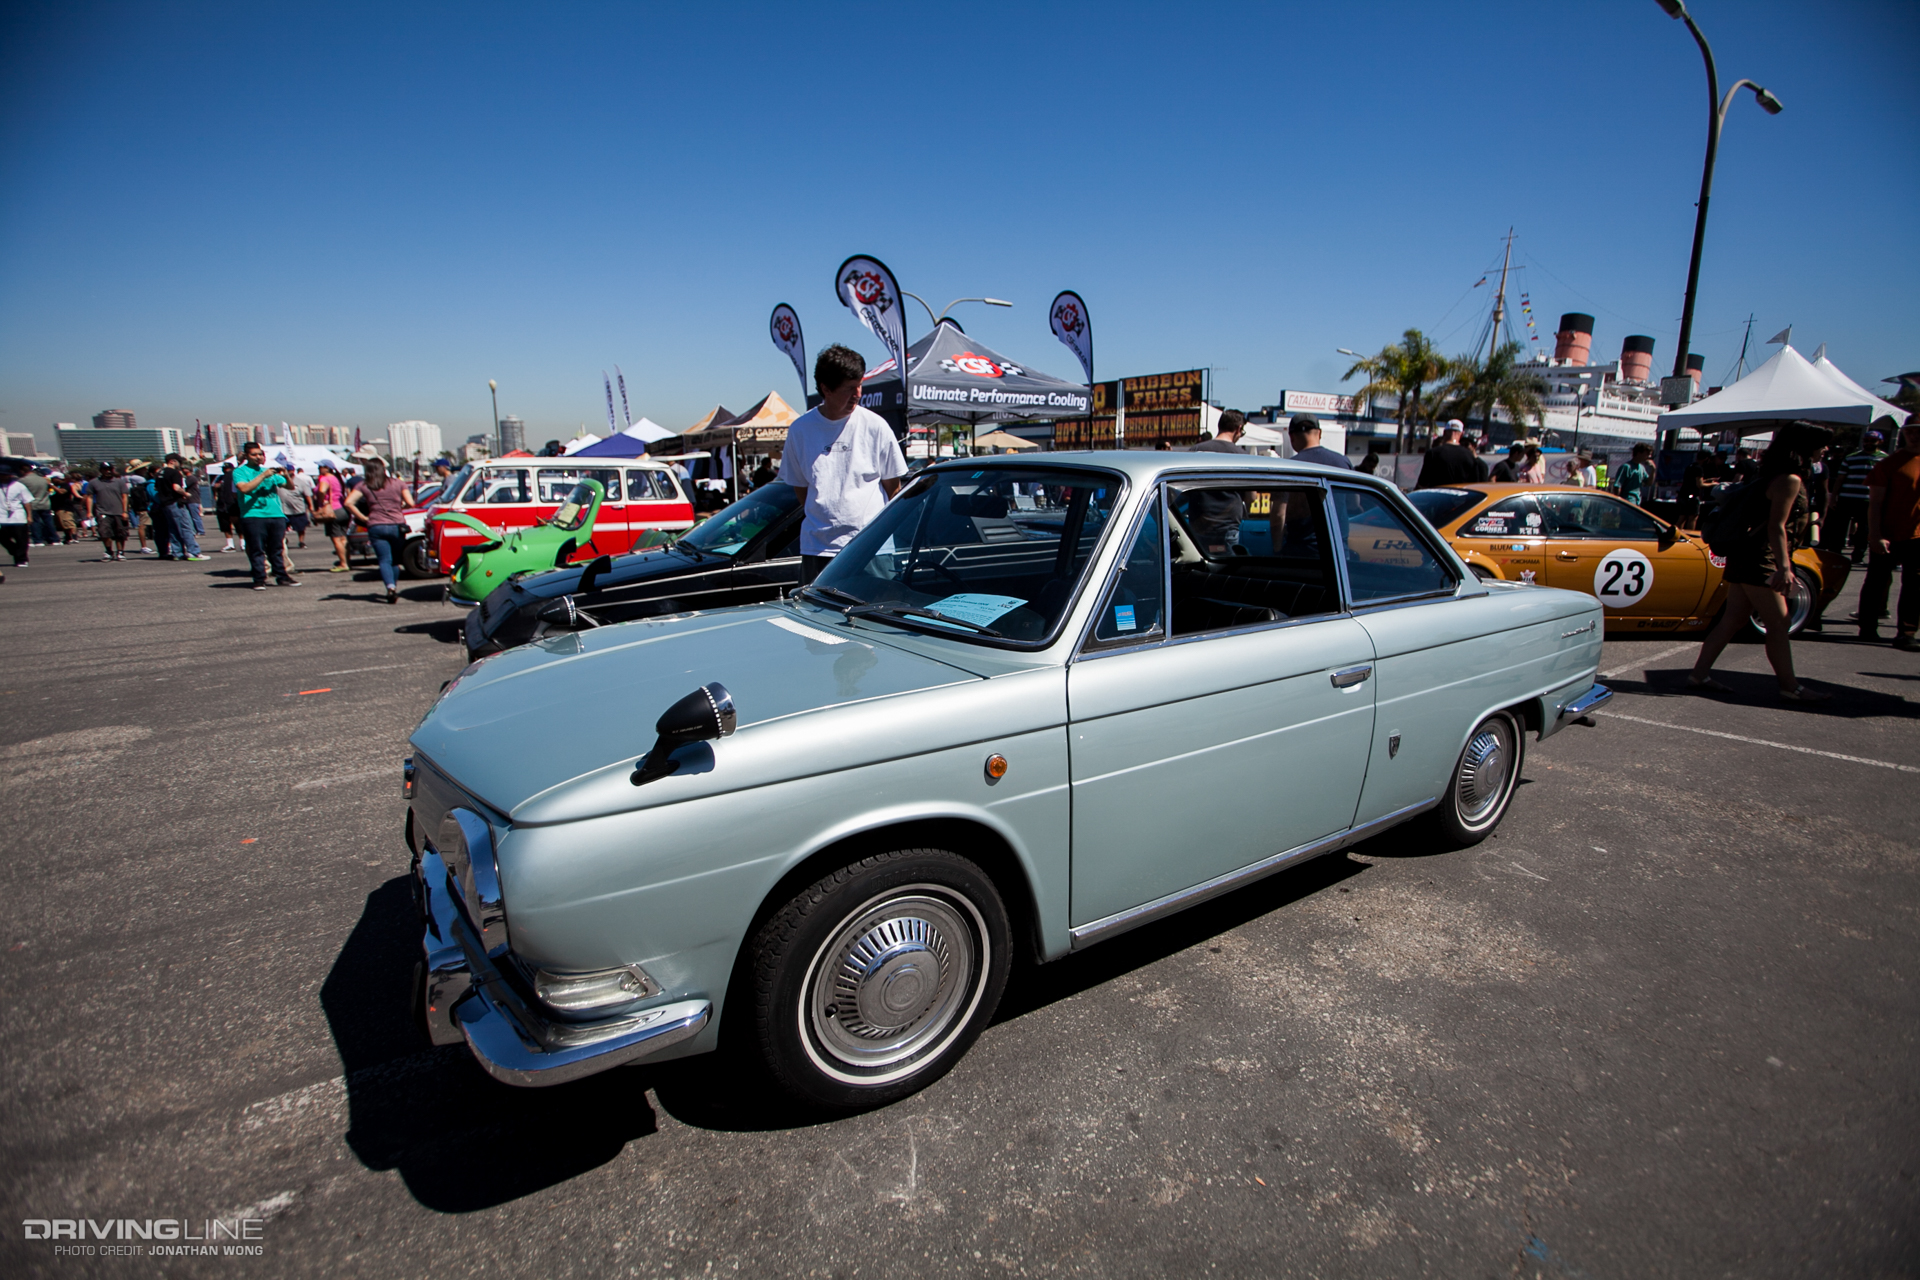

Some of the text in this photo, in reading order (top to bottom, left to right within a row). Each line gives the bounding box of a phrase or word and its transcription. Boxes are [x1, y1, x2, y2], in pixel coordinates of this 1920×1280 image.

[856, 276, 880, 299] CSF
[957, 357, 996, 375] CSF
[1125, 370, 1201, 392] RIBBON
[913, 385, 967, 402] Ultimate
[970, 388, 1045, 406] Performance
[1048, 392, 1088, 411] Cooling
[1133, 387, 1192, 405] FRIES
[1287, 394, 1326, 410] CATALINA
[1055, 421, 1077, 443] HOT
[1125, 413, 1200, 438] CHICKEN FINGERS
[1601, 561, 1646, 596] 23
